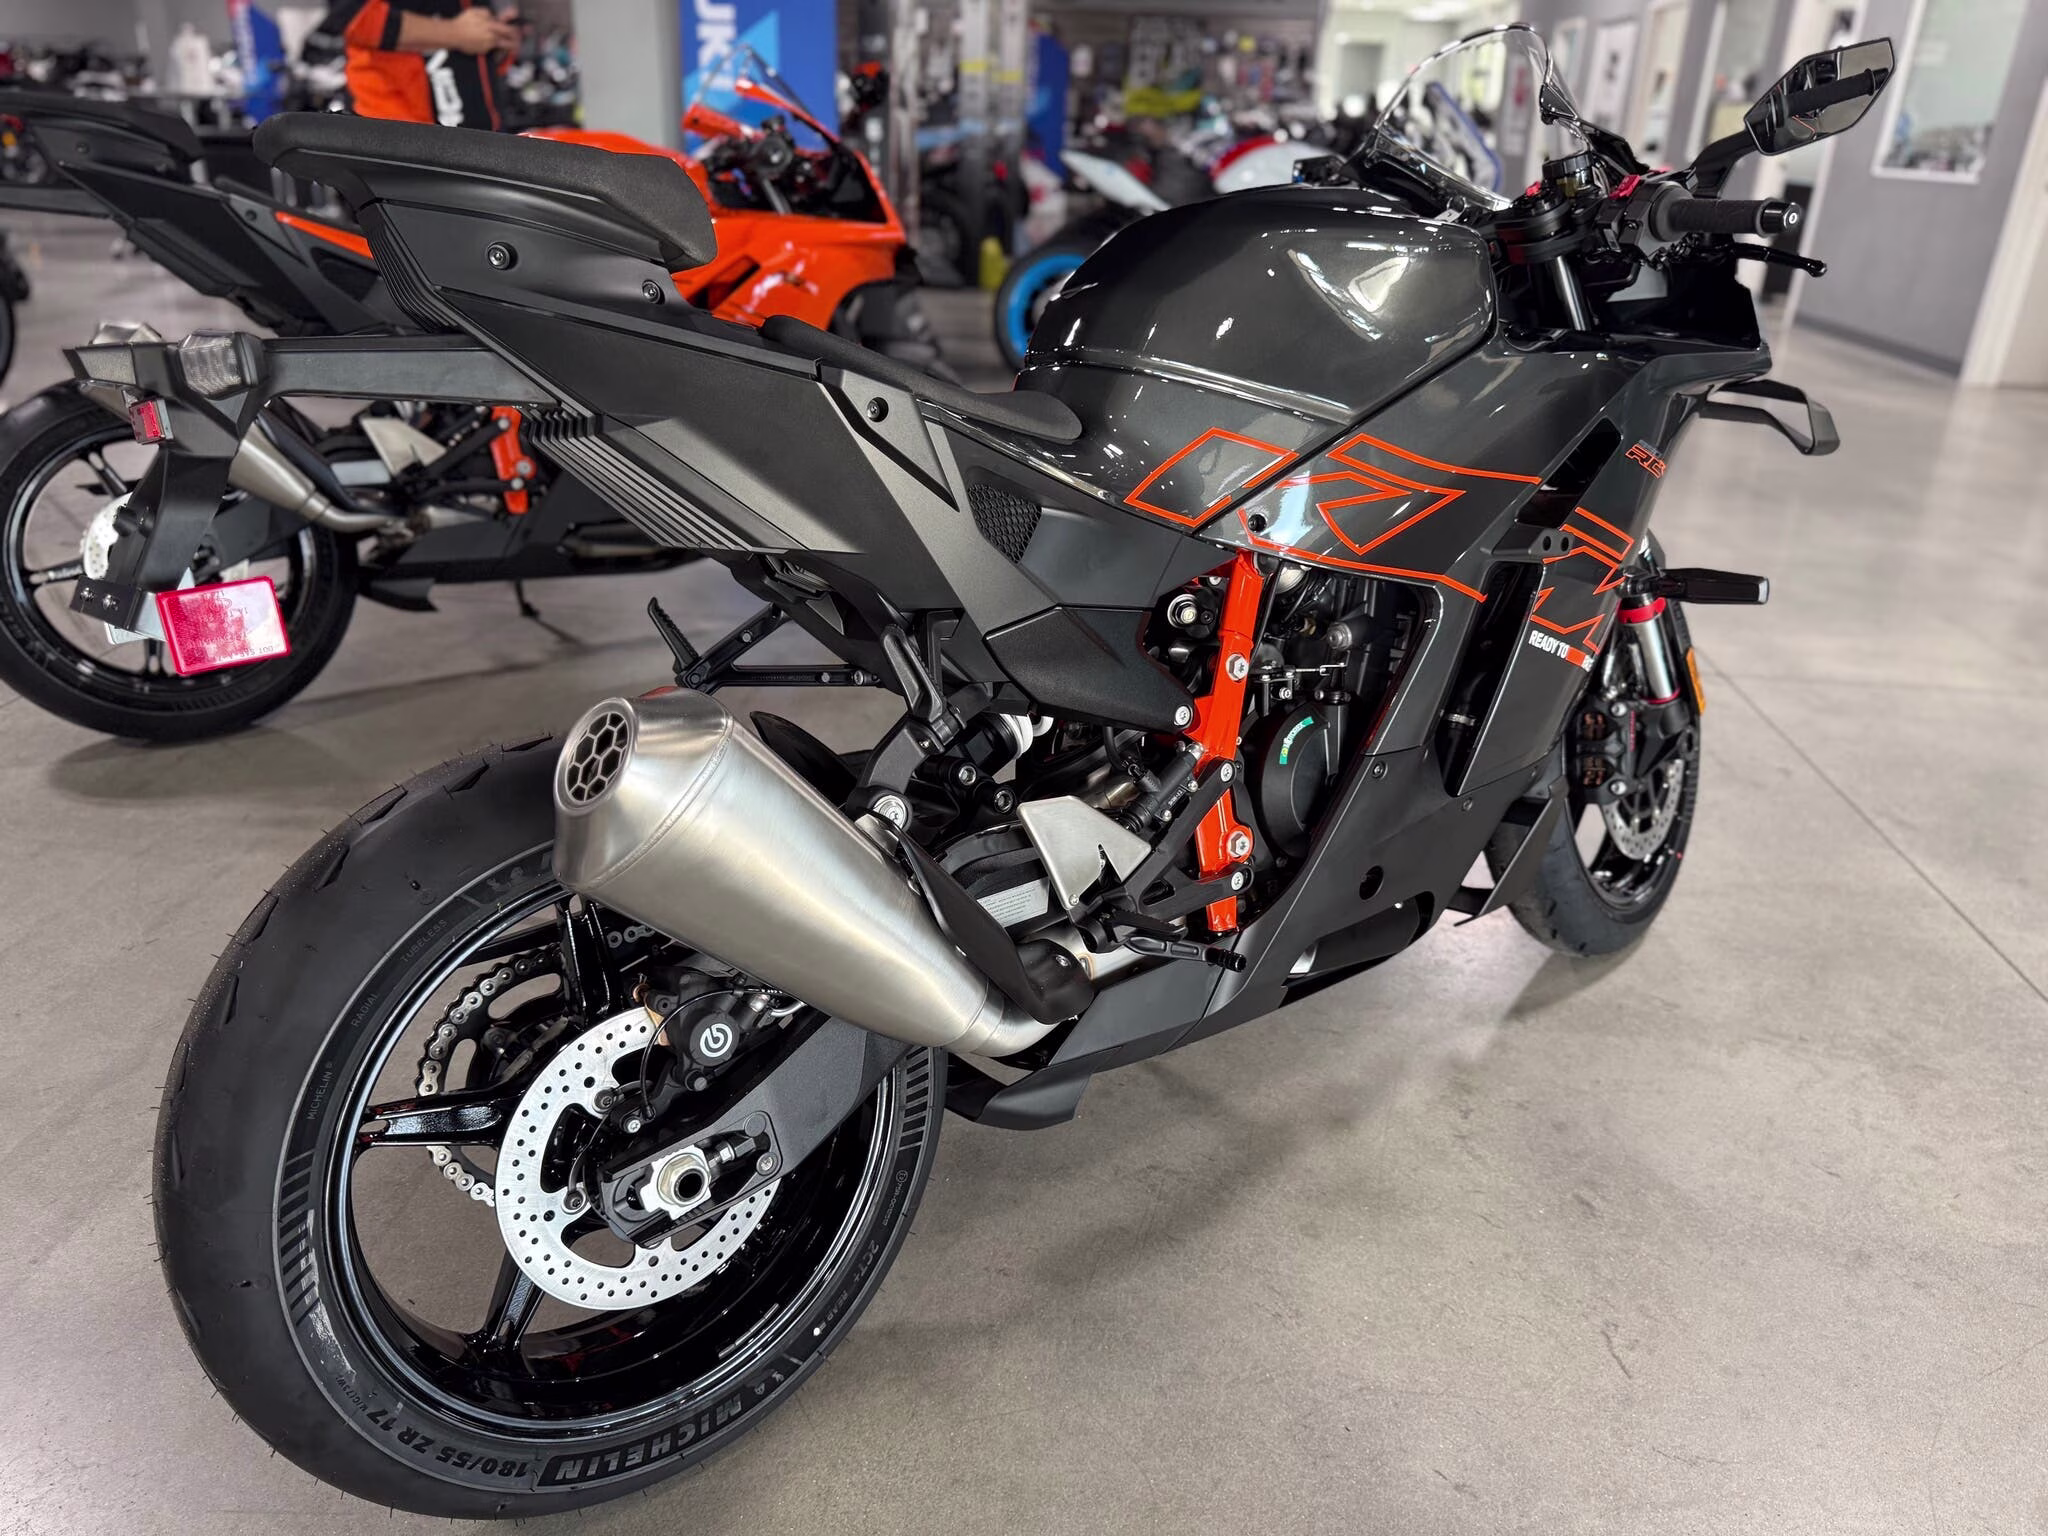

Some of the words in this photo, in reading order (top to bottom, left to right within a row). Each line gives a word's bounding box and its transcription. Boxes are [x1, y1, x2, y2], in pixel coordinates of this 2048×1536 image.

[1528, 630, 1560, 654] READY
[1557, 641, 1571, 659] TO
[306, 1070, 333, 1121] MICHELIN
[350, 992, 380, 1028] RADIAL
[400, 918, 449, 964] TUBELESS
[852, 1240, 879, 1282] 2CT+
[365, 1406, 400, 1433] 17
[396, 1425, 436, 1455] ZR
[555, 1397, 743, 1481] MICHELIN
[434, 1446, 529, 1479] 180/55
